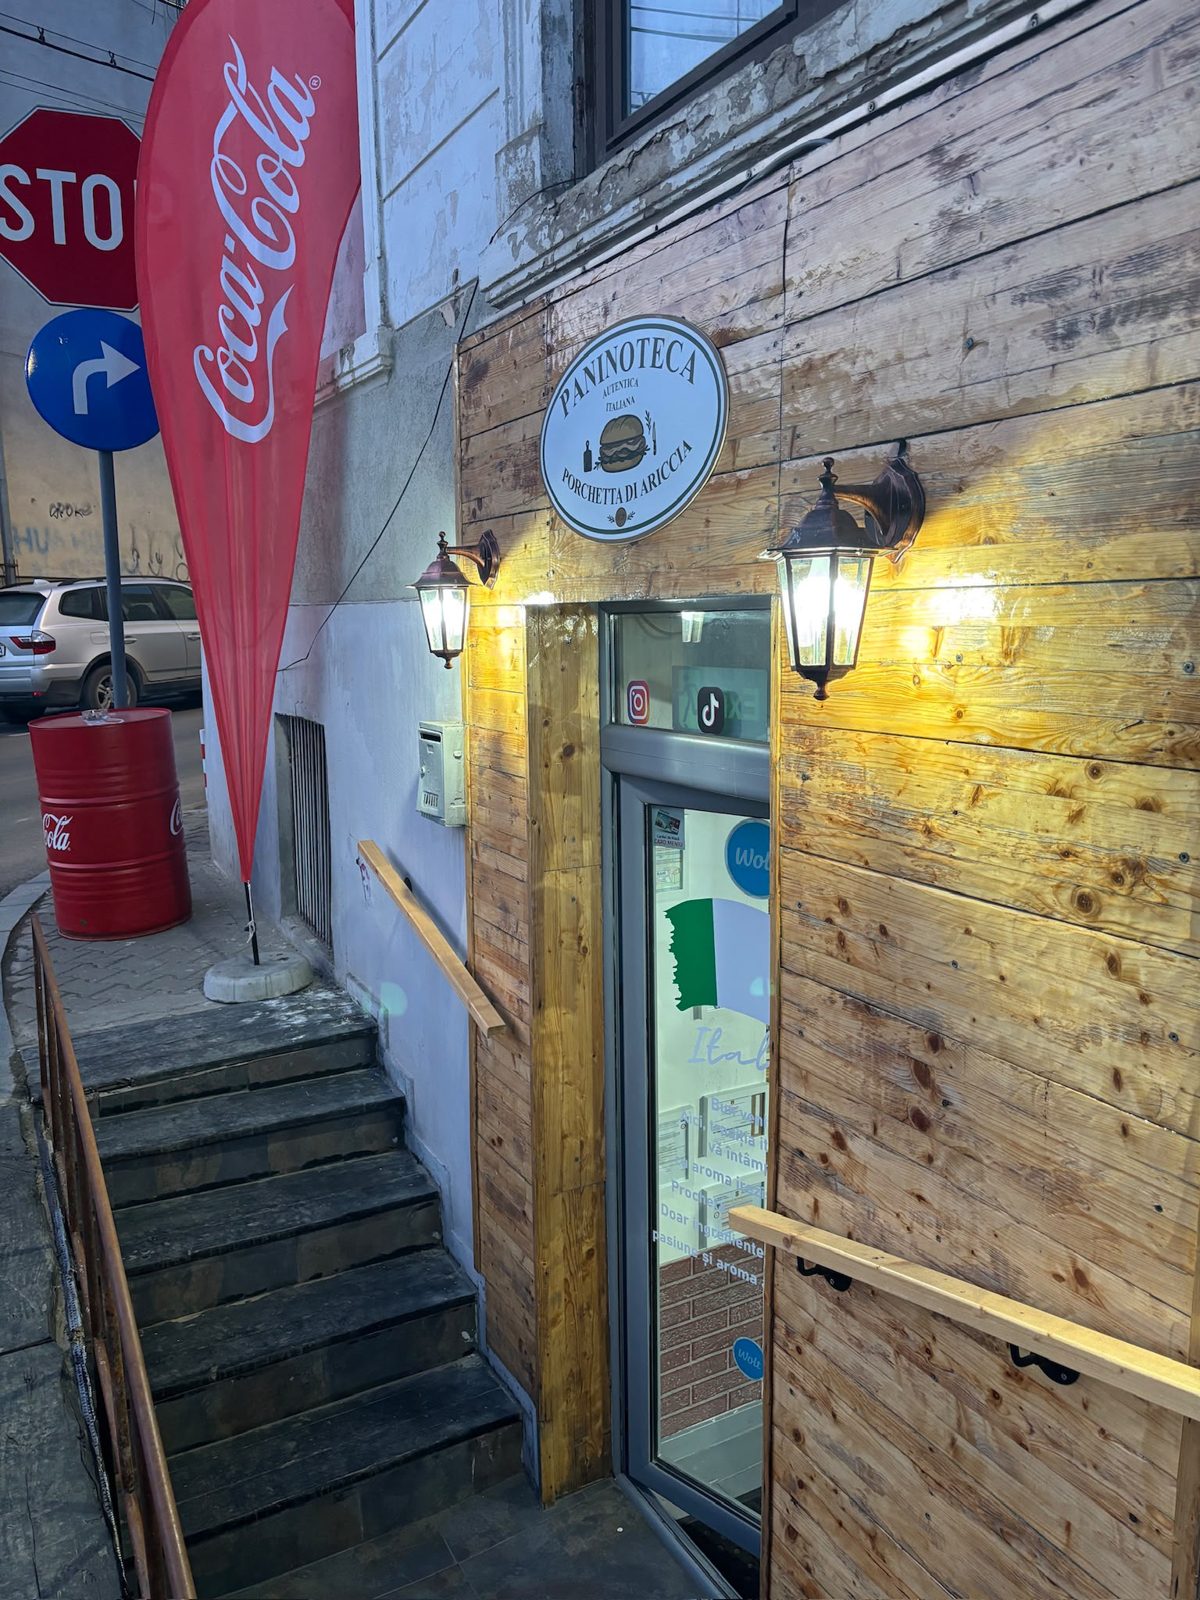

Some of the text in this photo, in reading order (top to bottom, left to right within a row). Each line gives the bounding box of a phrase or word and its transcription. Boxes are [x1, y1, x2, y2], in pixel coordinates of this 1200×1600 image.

[0, 163, 137, 251] STO
[194, 34, 316, 443] Coca-Cola
[559, 337, 698, 420] PANINOTECA
[602, 377, 639, 399] AUTENTICA
[605, 396, 636, 412] ITALIANA
[562, 439, 693, 506] PORCHETTA DI ARICCIA
[735, 847, 770, 871] Wol
[688, 1026, 770, 1071] Ital
[692, 1161, 732, 1186] aroma
[660, 1202, 689, 1225] Doar
[716, 1259, 758, 1285] aroma
